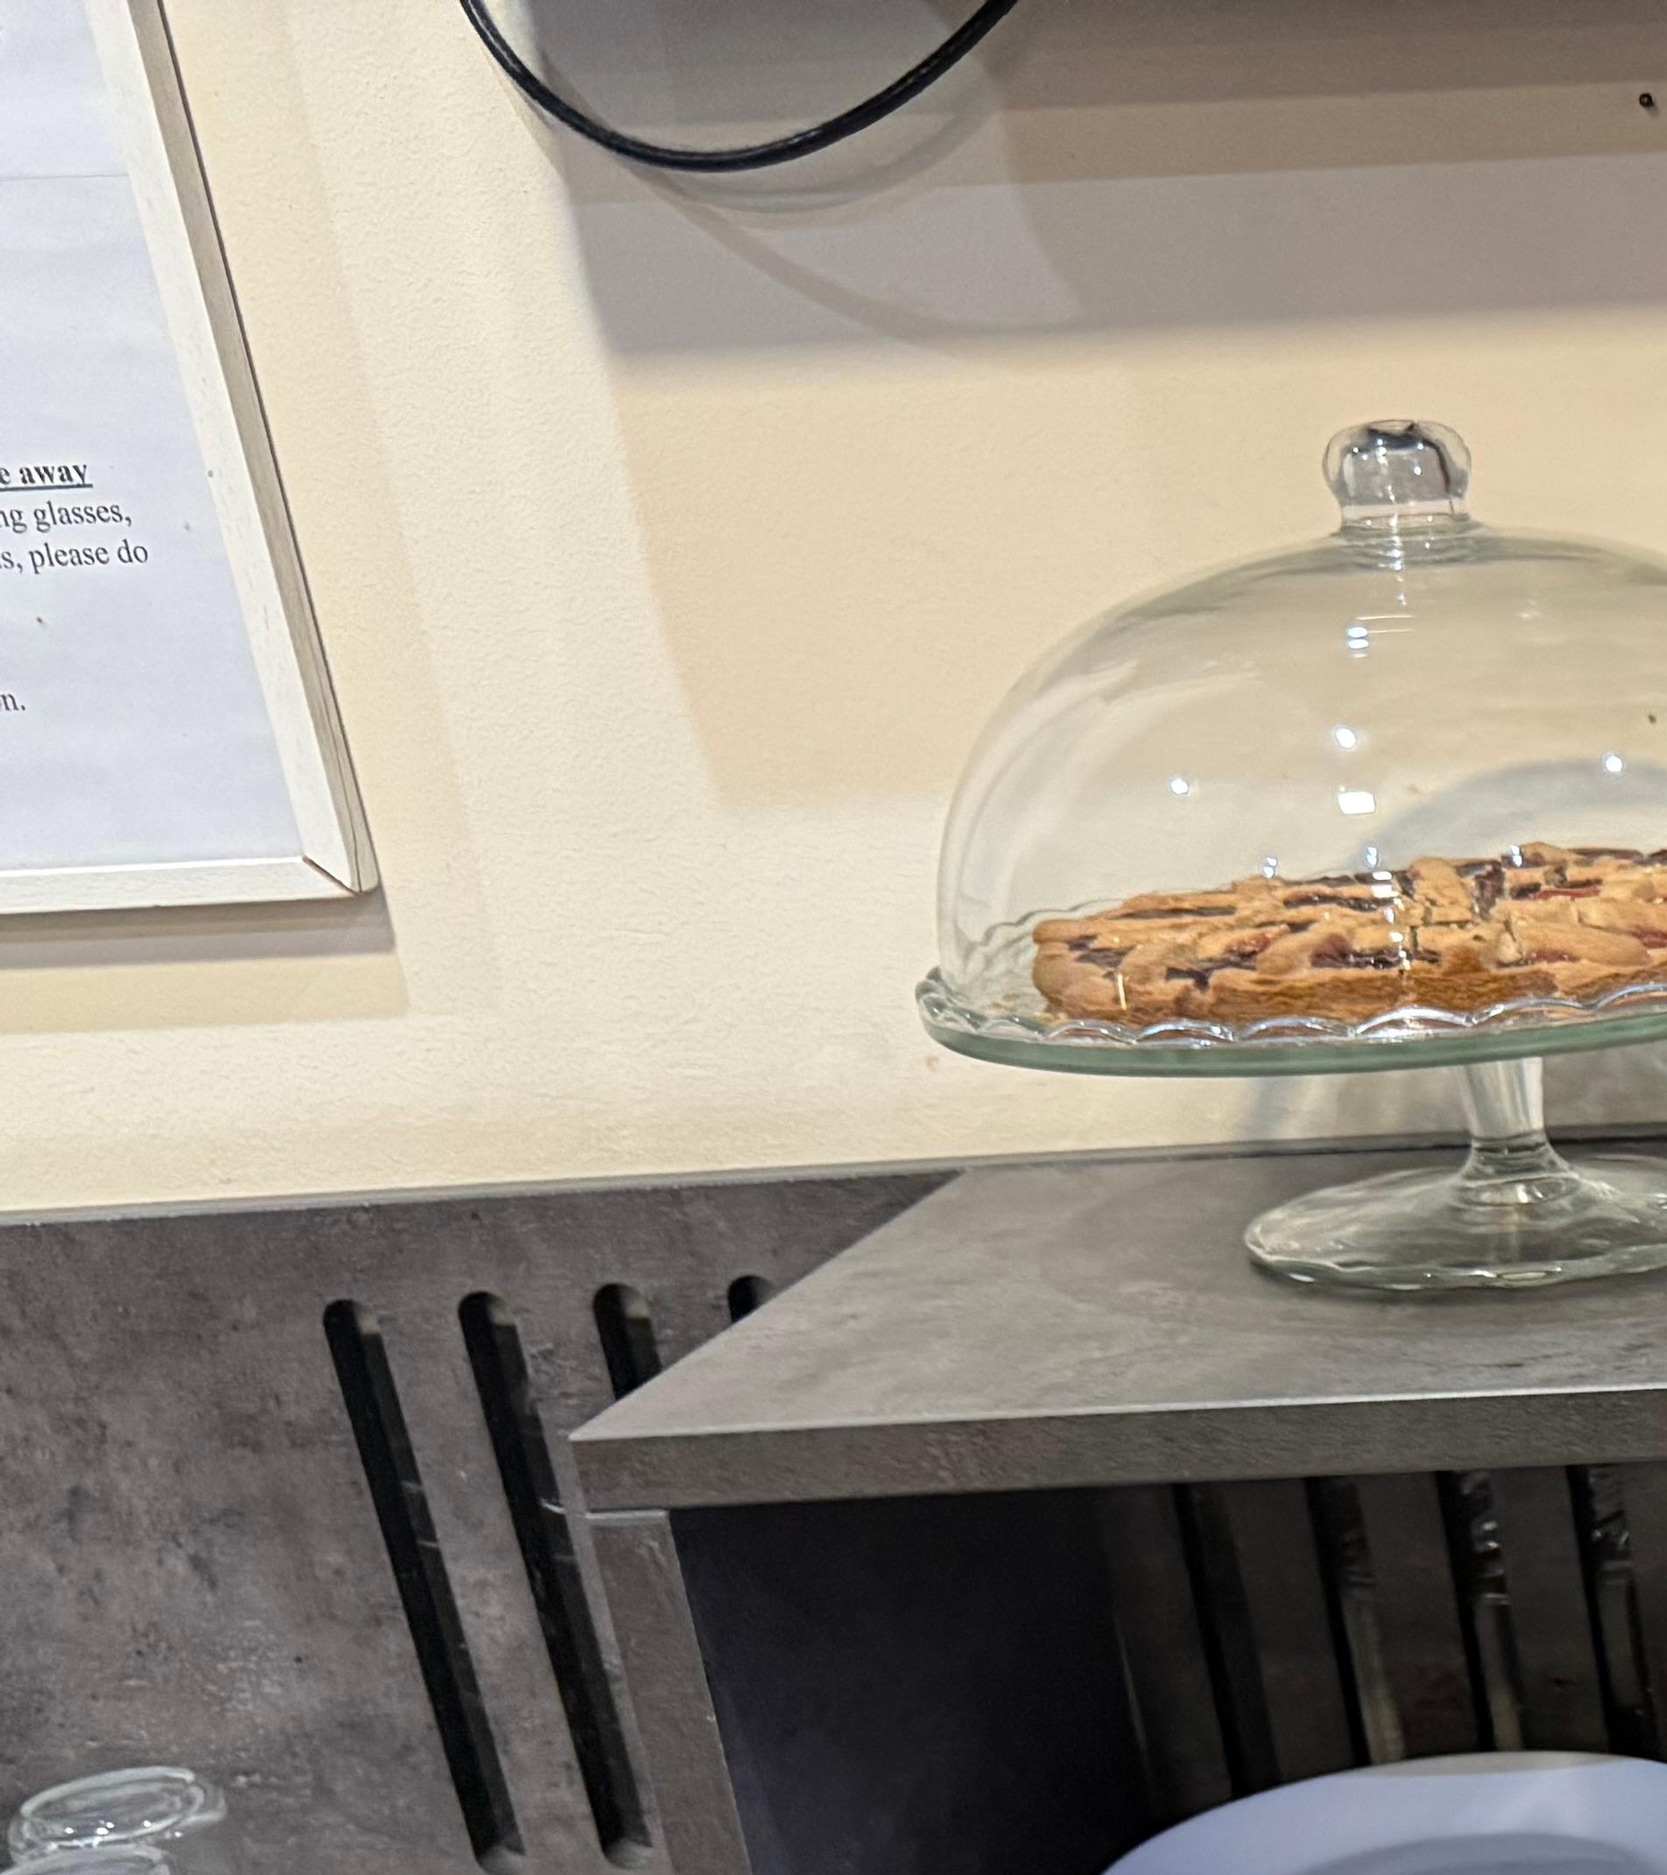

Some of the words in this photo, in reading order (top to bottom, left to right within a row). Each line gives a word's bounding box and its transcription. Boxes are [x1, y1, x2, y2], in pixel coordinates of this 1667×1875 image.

[19, 464, 88, 487] away
[33, 500, 133, 534] glasses,
[28, 541, 111, 575] please
[117, 538, 149, 564] do
